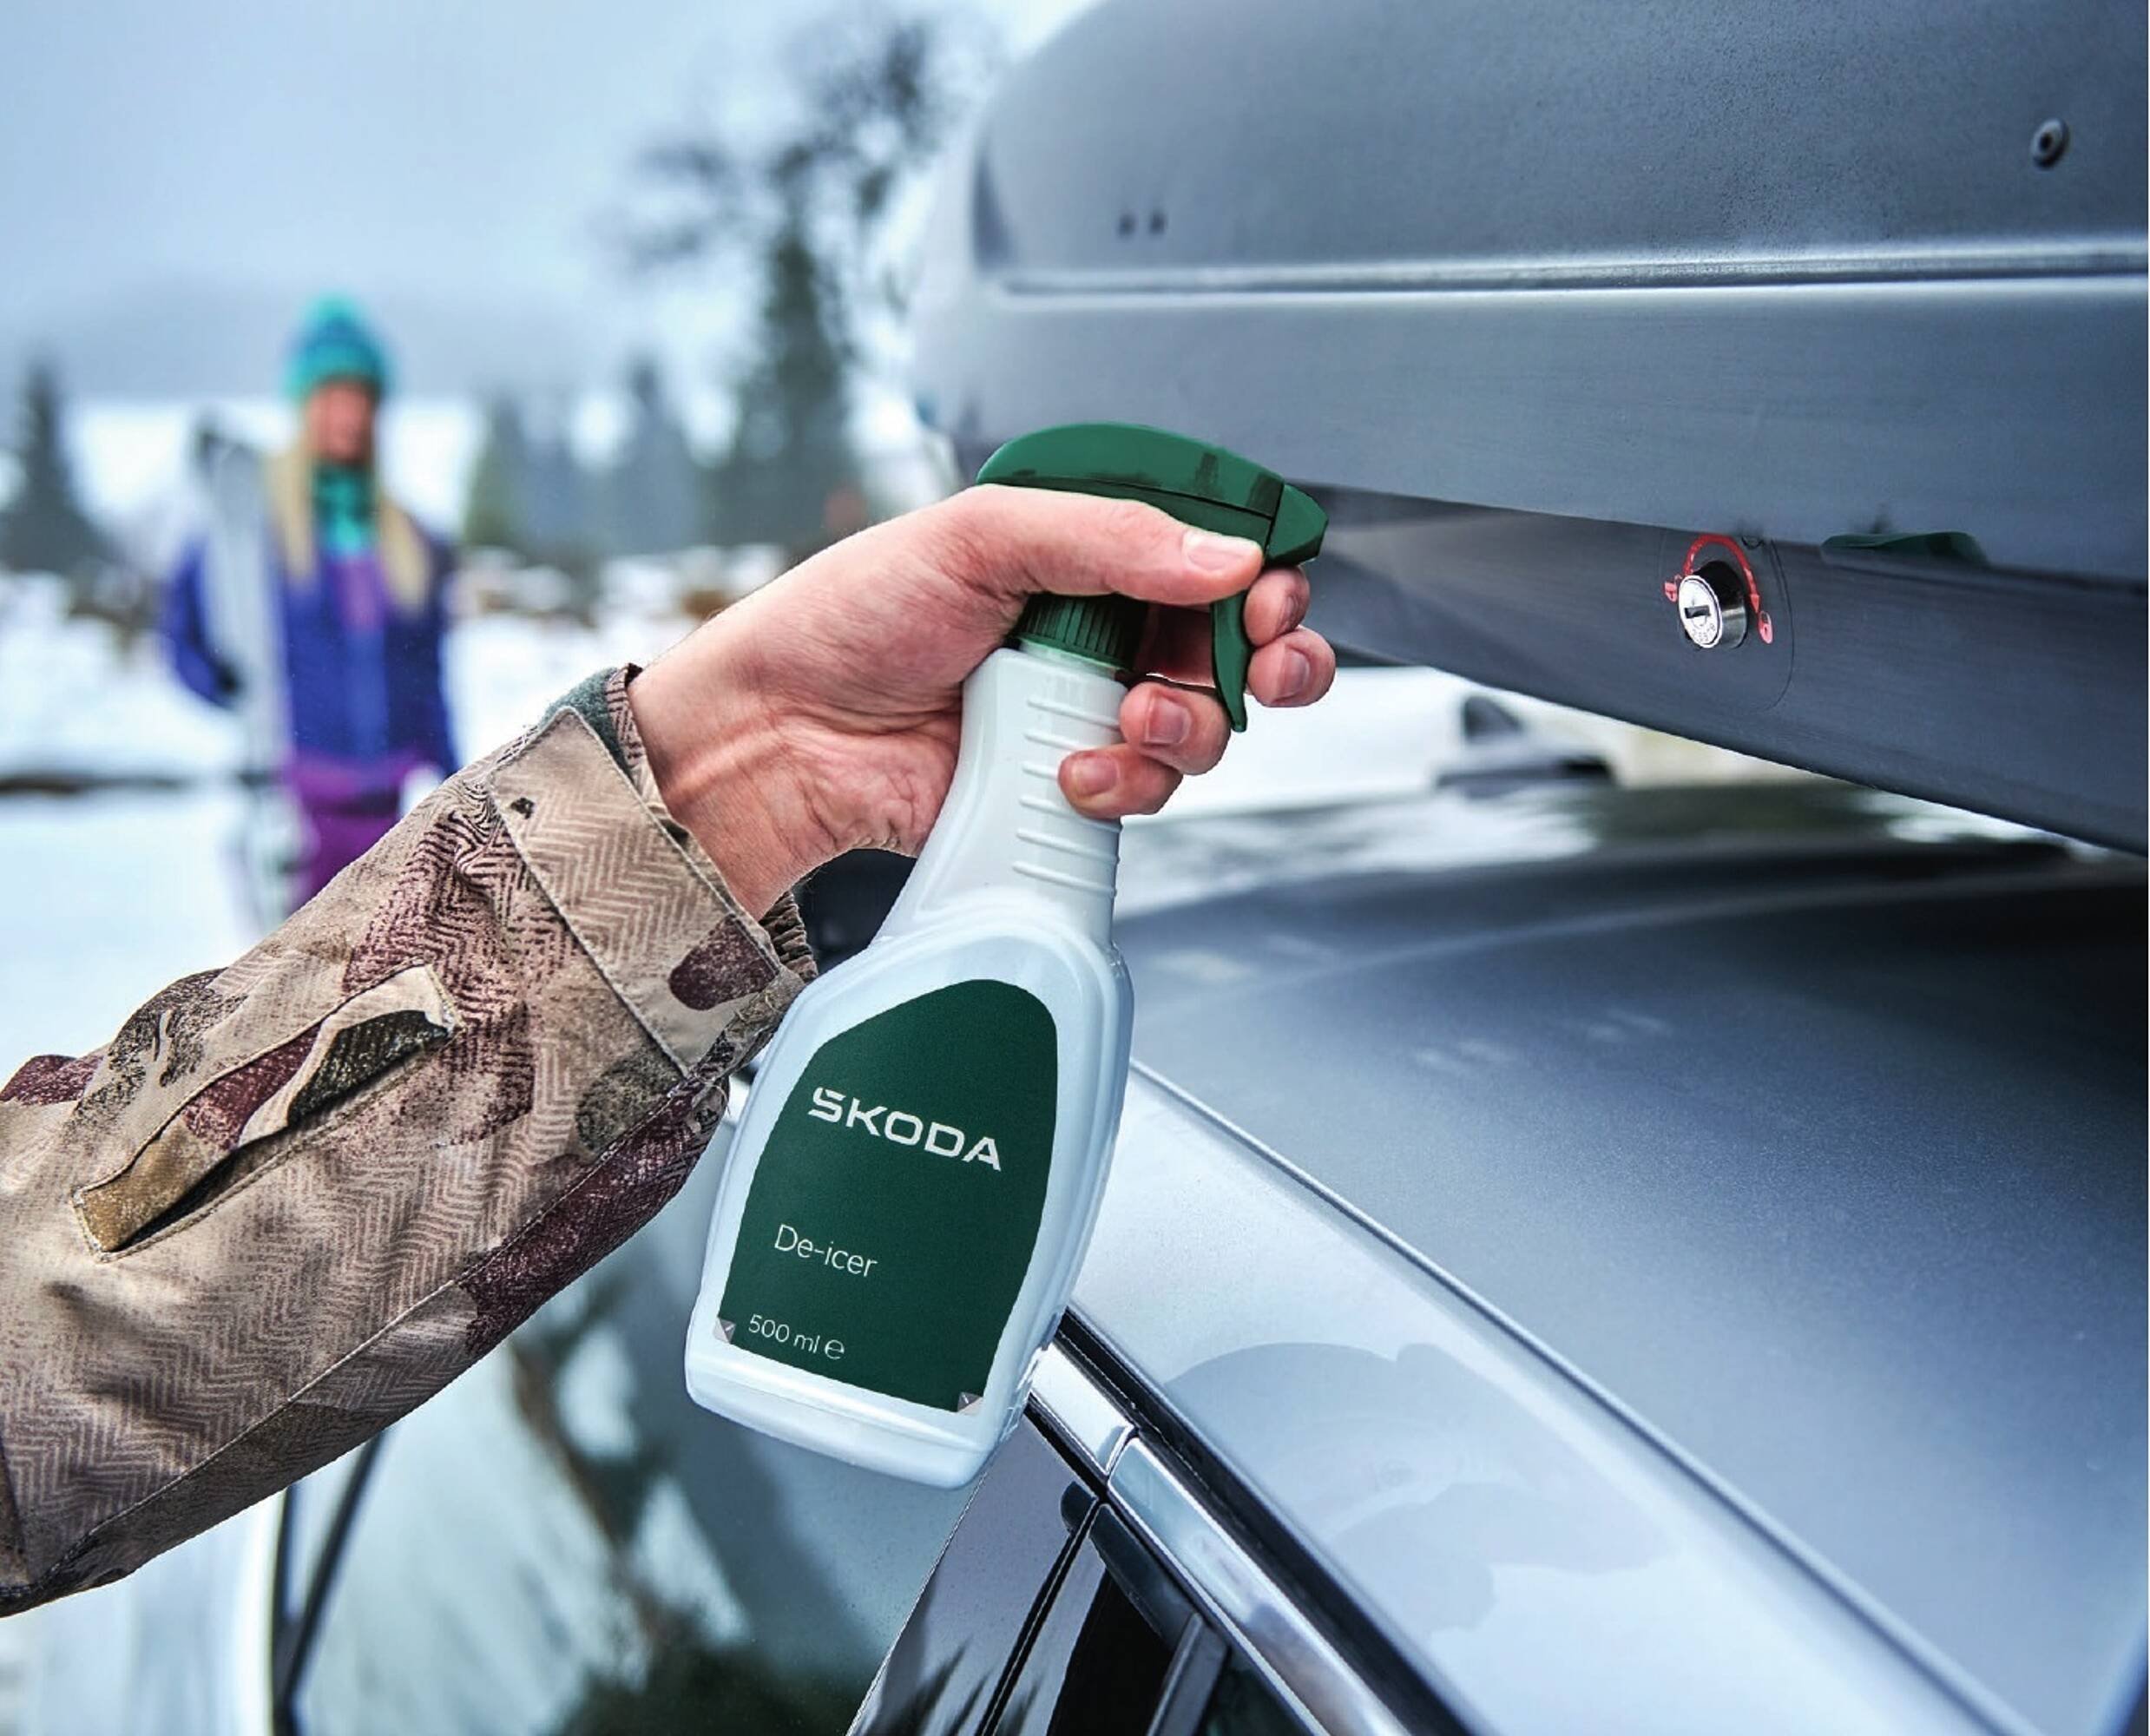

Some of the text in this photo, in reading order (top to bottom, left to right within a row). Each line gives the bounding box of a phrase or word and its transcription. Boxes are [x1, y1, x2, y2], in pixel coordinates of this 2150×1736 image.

[774, 1224, 878, 1277] De-icer
[748, 1313, 790, 1343] 500
[792, 1335, 820, 1354] ml
